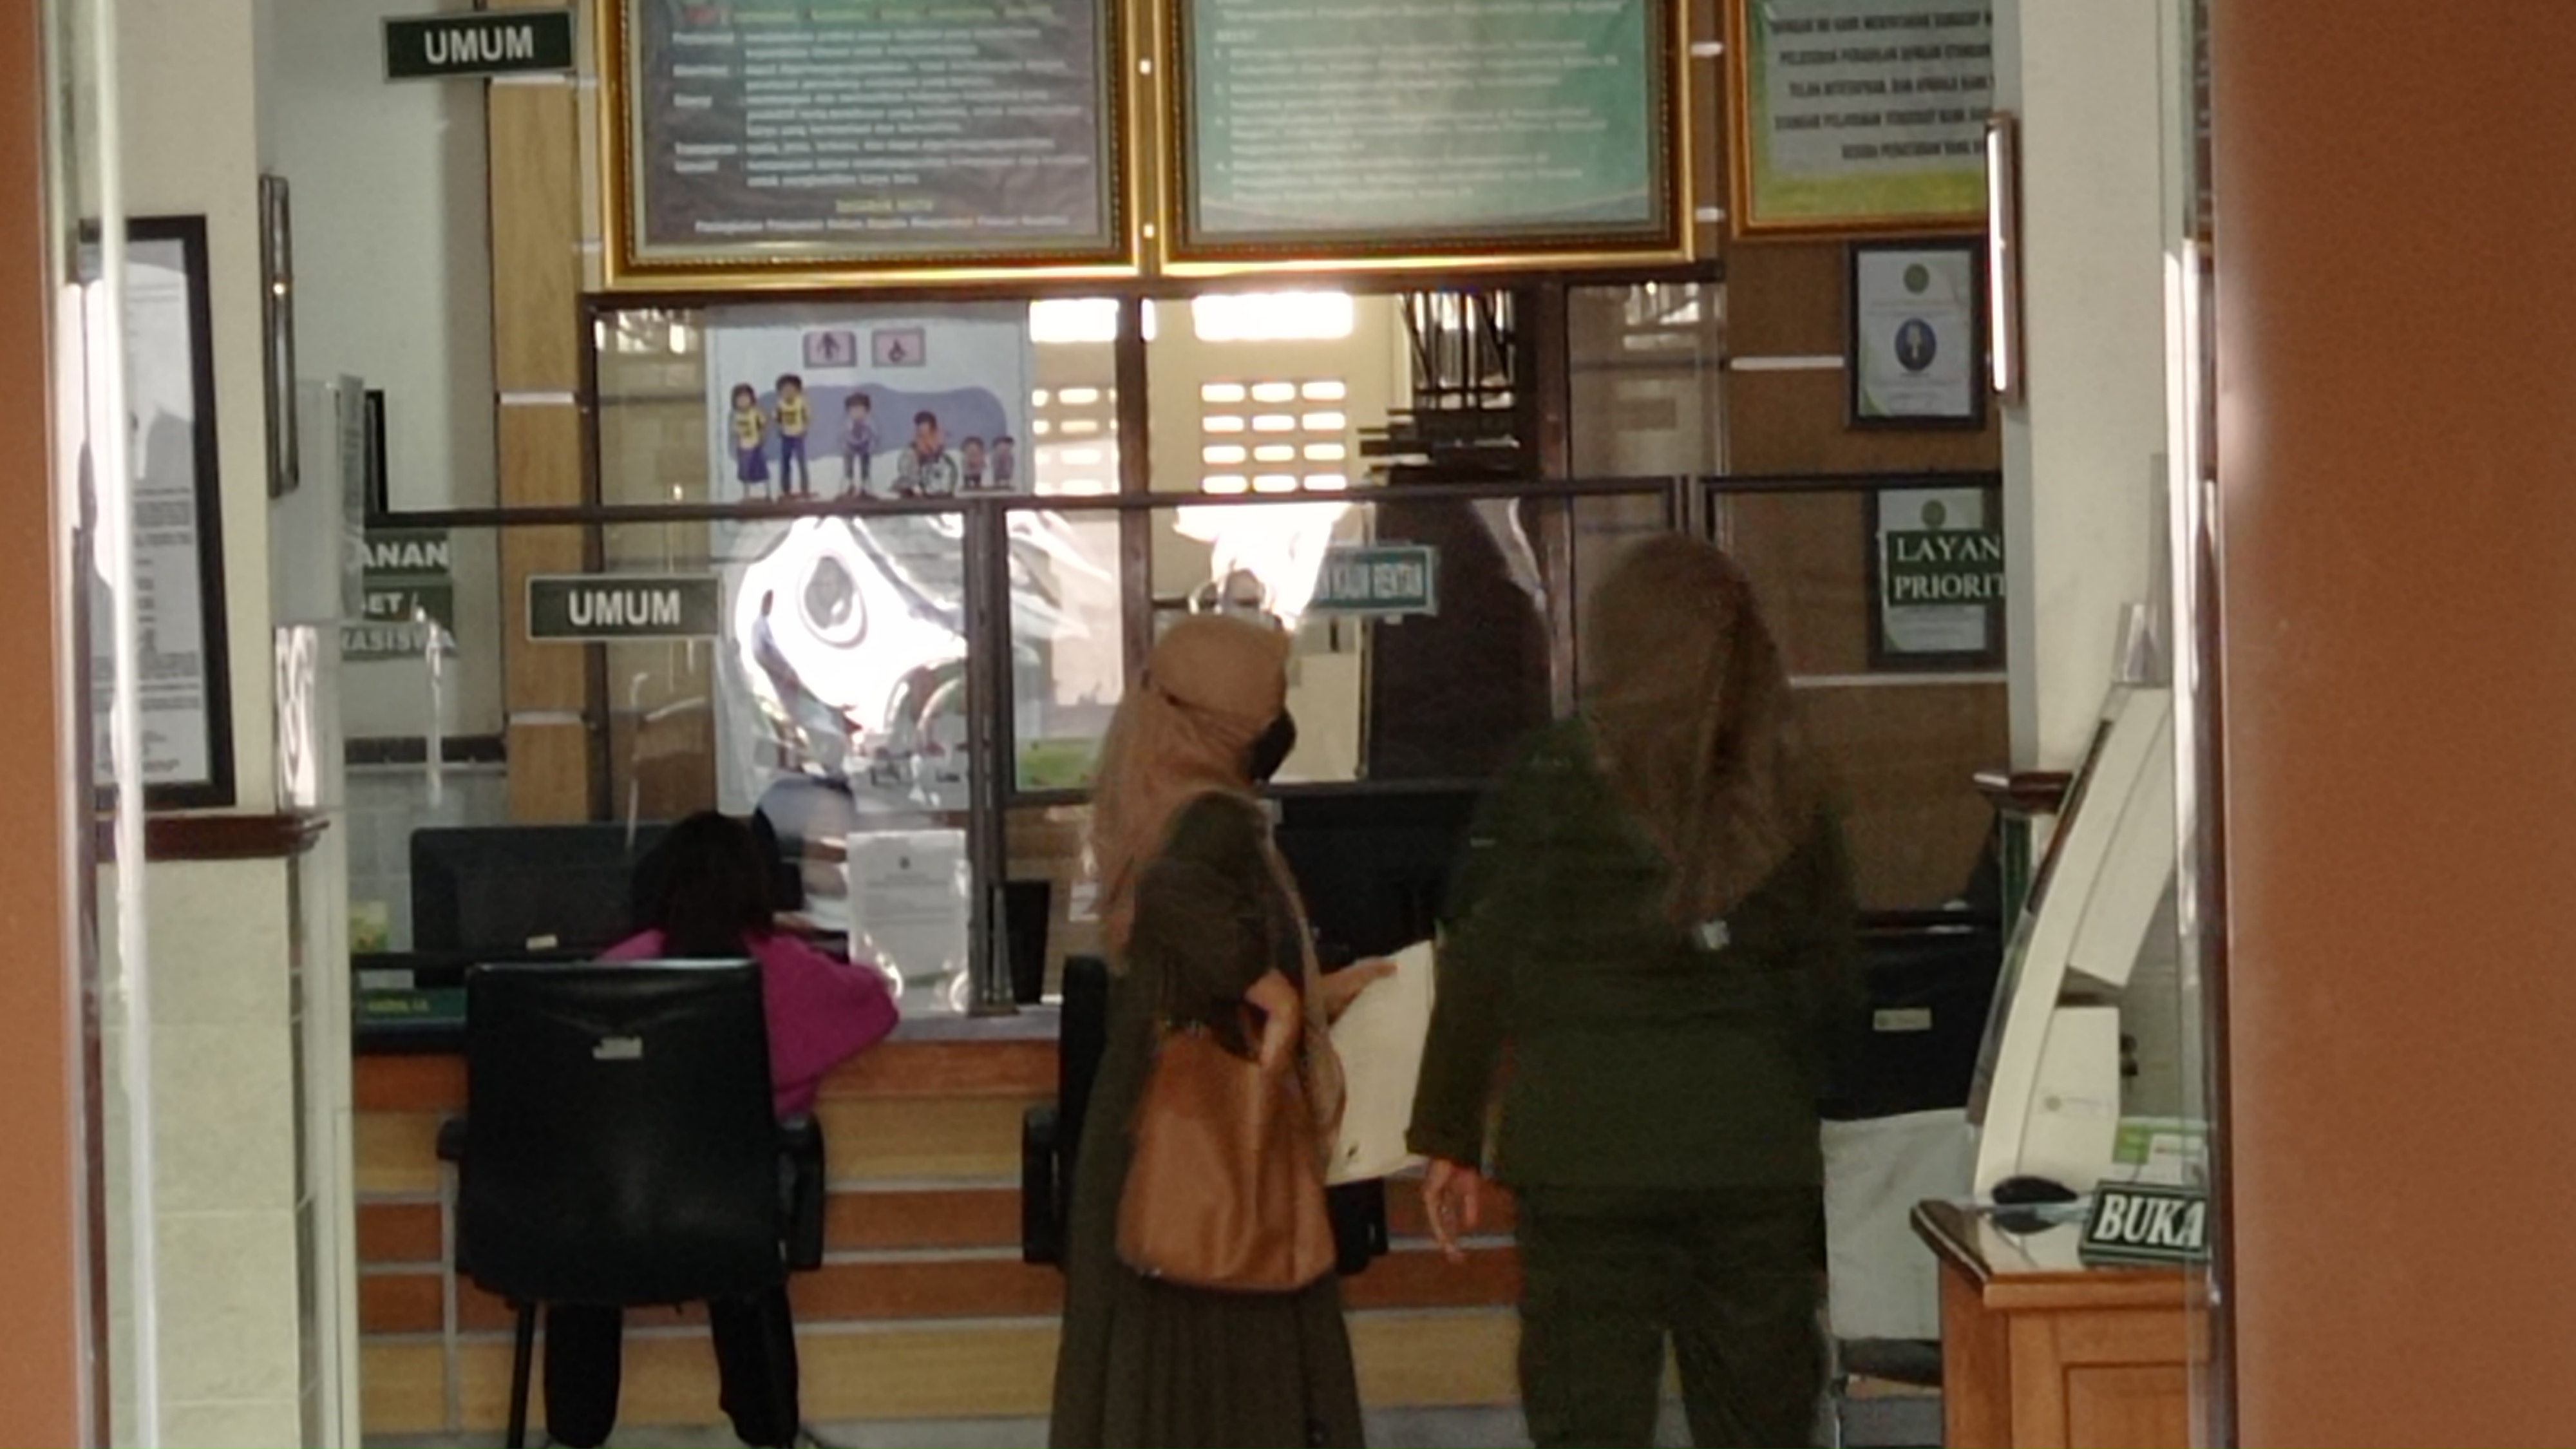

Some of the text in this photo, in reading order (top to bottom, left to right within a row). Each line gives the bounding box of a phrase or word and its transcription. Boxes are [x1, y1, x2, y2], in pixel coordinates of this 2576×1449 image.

[424, 25, 534, 64] UMUM
[1897, 535, 2001, 562] LAYAN
[363, 592, 404, 614] ET
[568, 589, 681, 626] UMUM
[2092, 1193, 2207, 1247] BUKA
